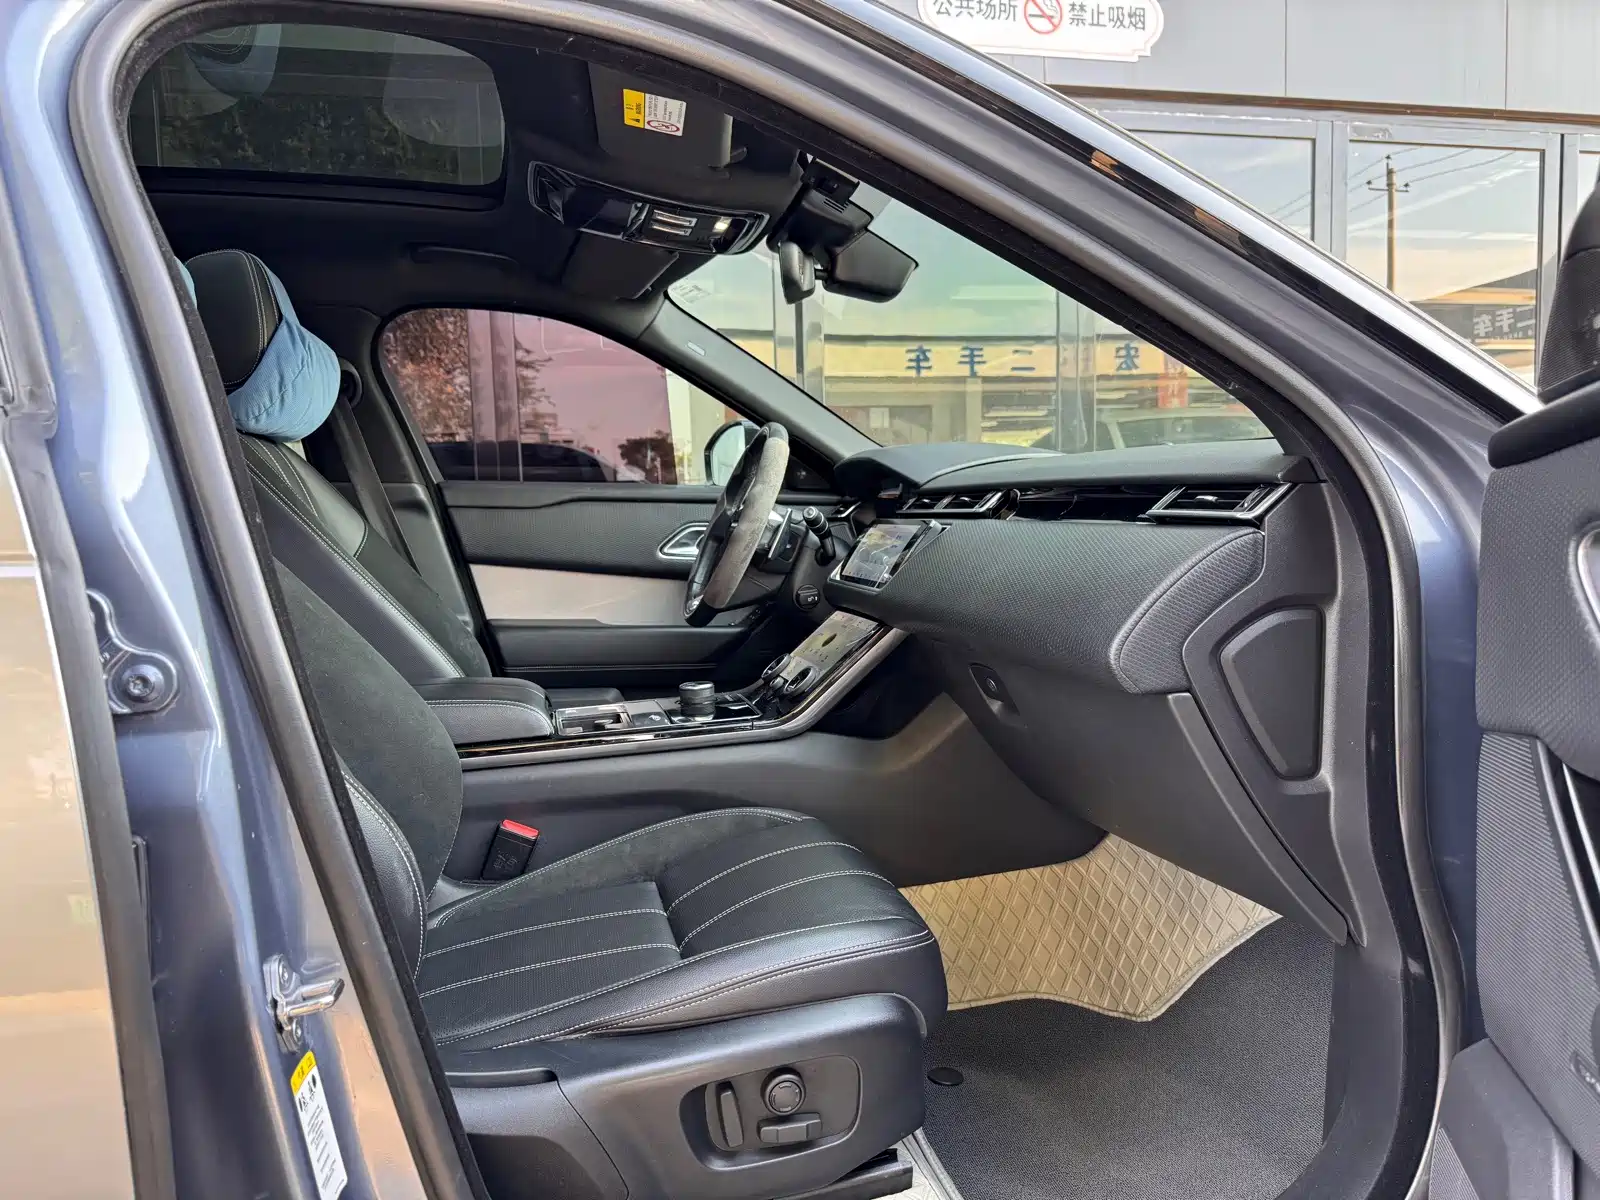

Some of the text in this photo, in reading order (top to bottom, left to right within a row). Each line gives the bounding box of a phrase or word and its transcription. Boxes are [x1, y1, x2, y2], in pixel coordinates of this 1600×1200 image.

[934, 0, 1147, 31] 公共场所 禁止吸烟
